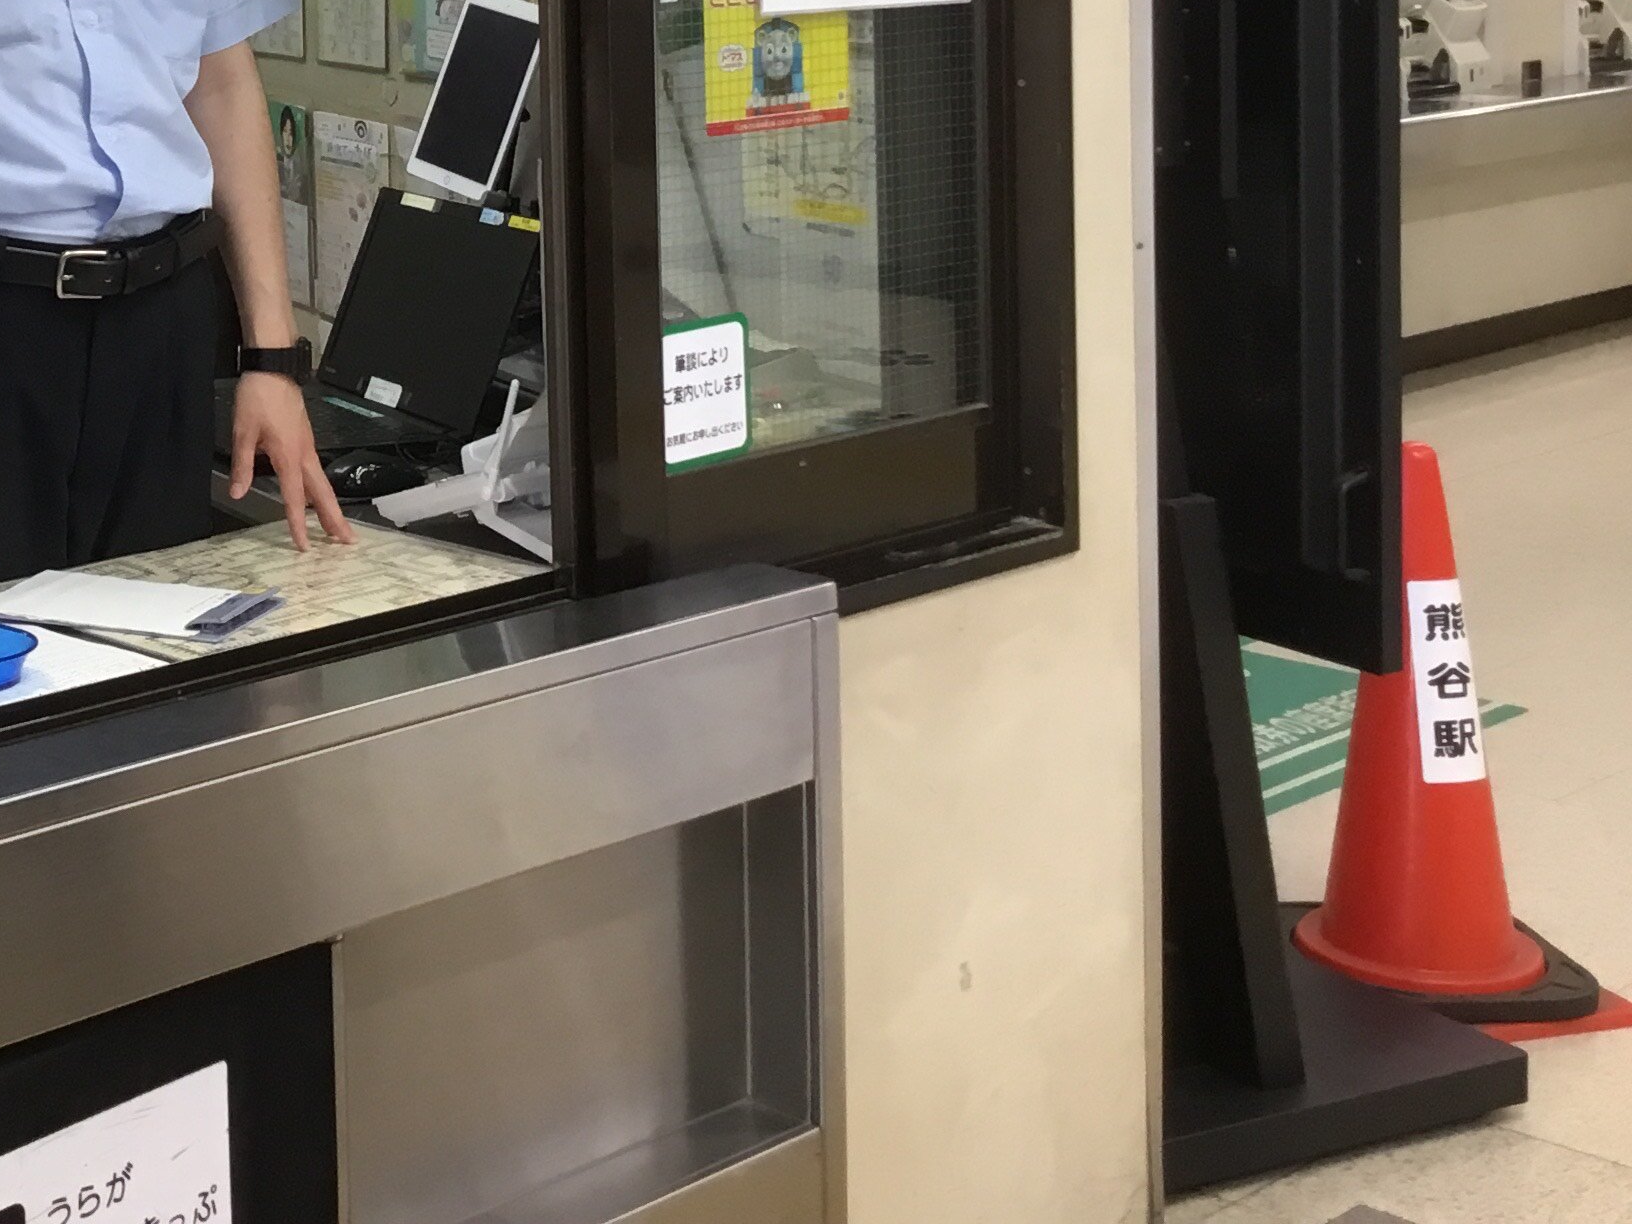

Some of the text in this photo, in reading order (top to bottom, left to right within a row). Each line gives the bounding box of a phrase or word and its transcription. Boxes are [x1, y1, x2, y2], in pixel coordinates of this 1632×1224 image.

[675, 347, 729, 373] 筆談により
[663, 374, 743, 406] ご案内いたします
[1423, 603, 1477, 758] 熊谷駅
[48, 1162, 134, 1224] うらが
